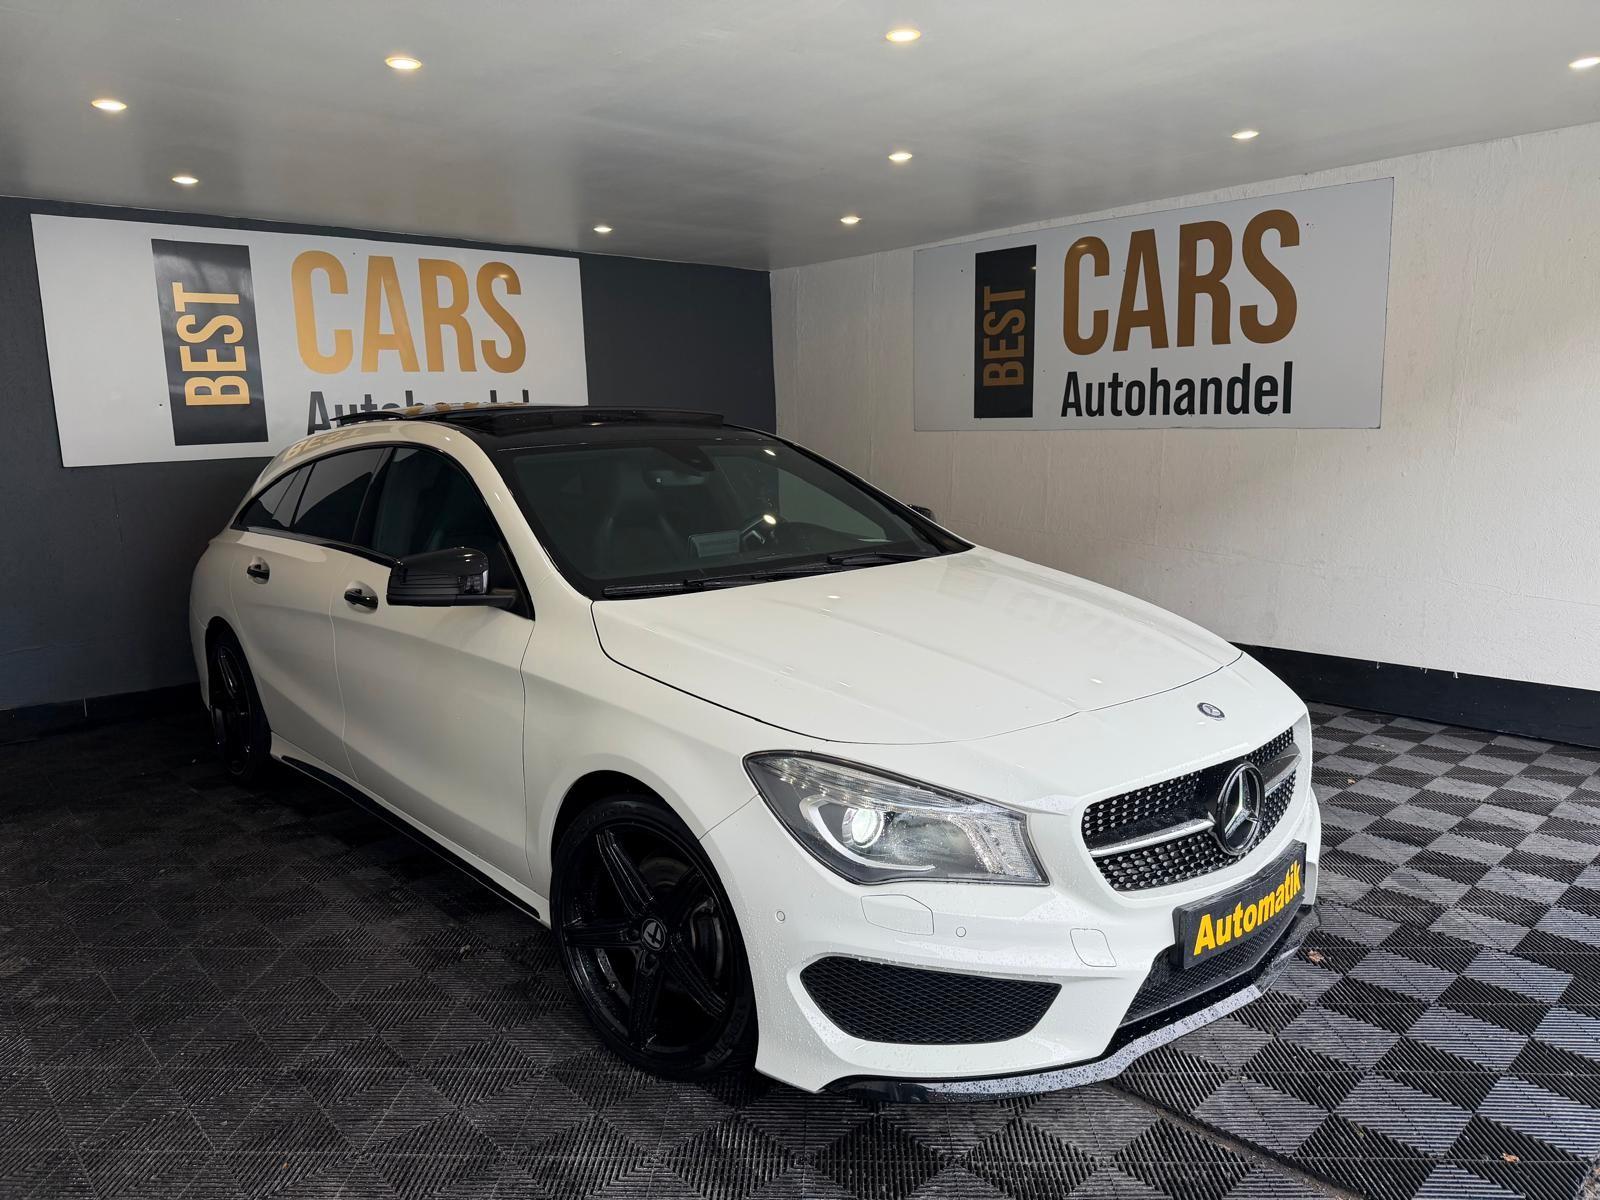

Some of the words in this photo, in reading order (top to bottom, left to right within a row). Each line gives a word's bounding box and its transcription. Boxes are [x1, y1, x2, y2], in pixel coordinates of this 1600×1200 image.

[290, 250, 527, 375] CARS
[983, 286, 1026, 388] BEST
[1062, 209, 1301, 356] CARS
[173, 281, 251, 407] BEST
[1060, 361, 1294, 418] Autohandel
[1193, 859, 1302, 957] Automatik
